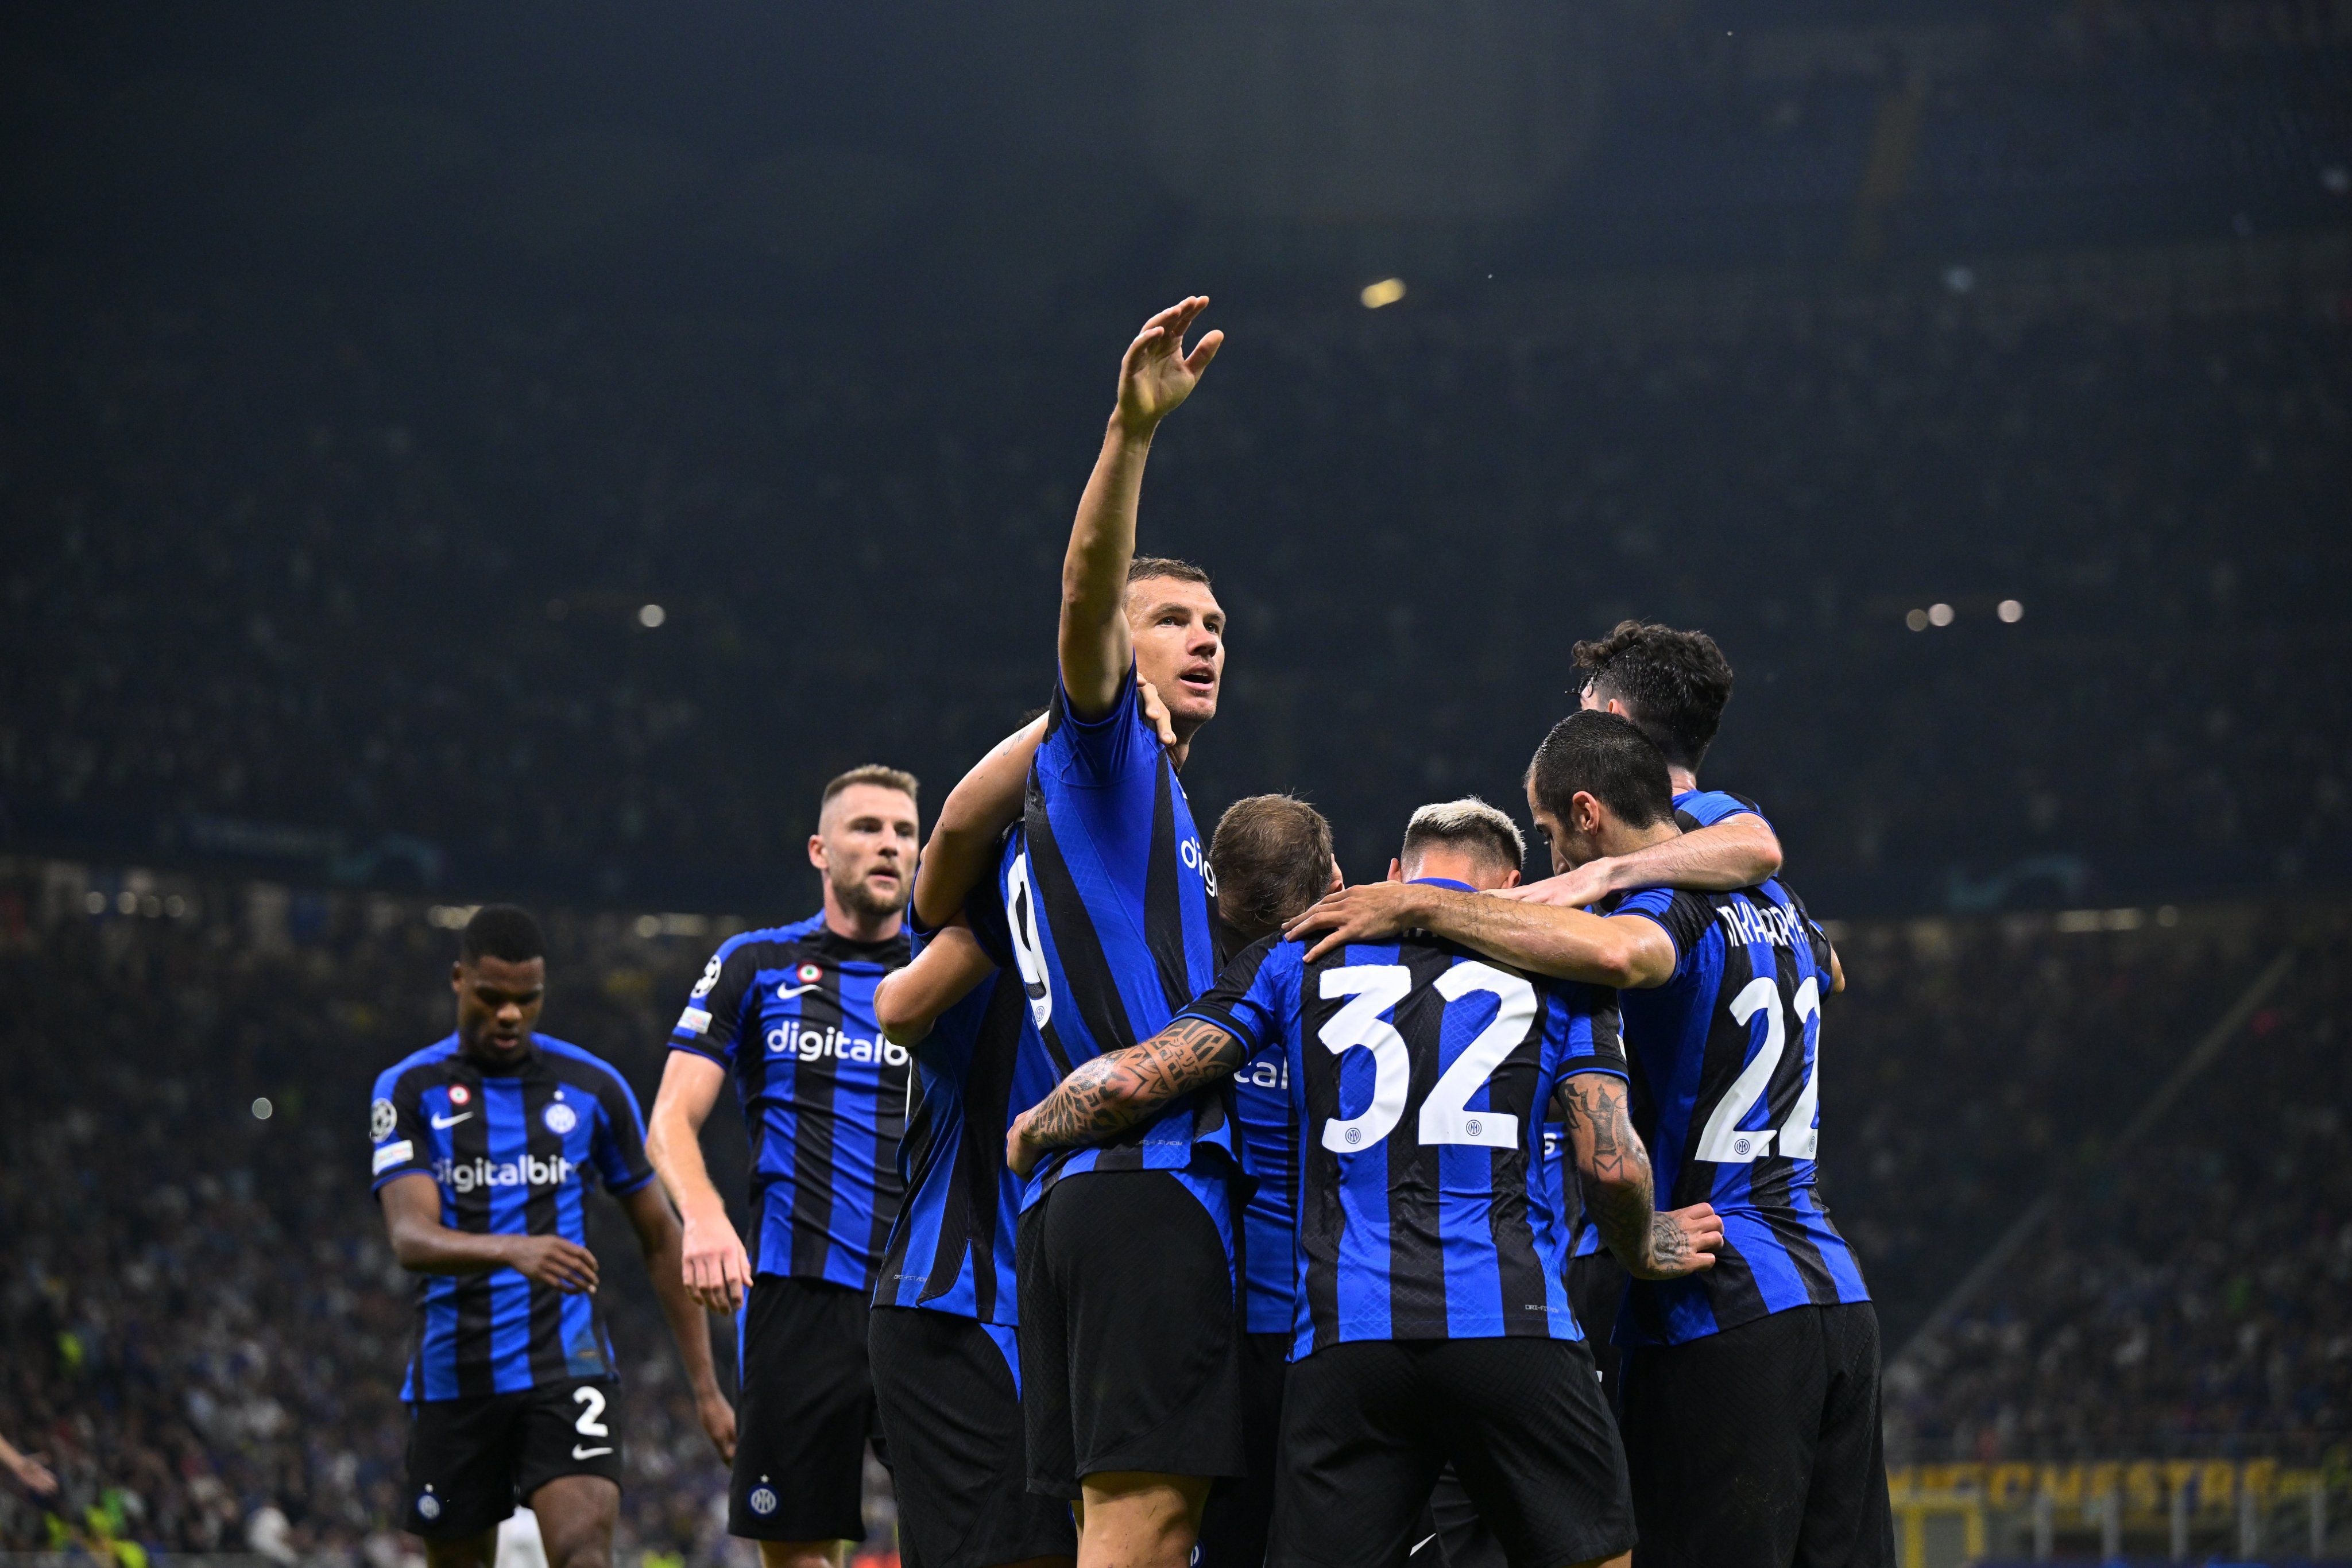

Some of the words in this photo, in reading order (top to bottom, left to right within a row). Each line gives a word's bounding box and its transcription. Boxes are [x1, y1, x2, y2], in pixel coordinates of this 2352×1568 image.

[1318, 961, 1538, 1150] 32
[1695, 976, 1820, 1163] 22
[573, 1385, 608, 1437] 2
